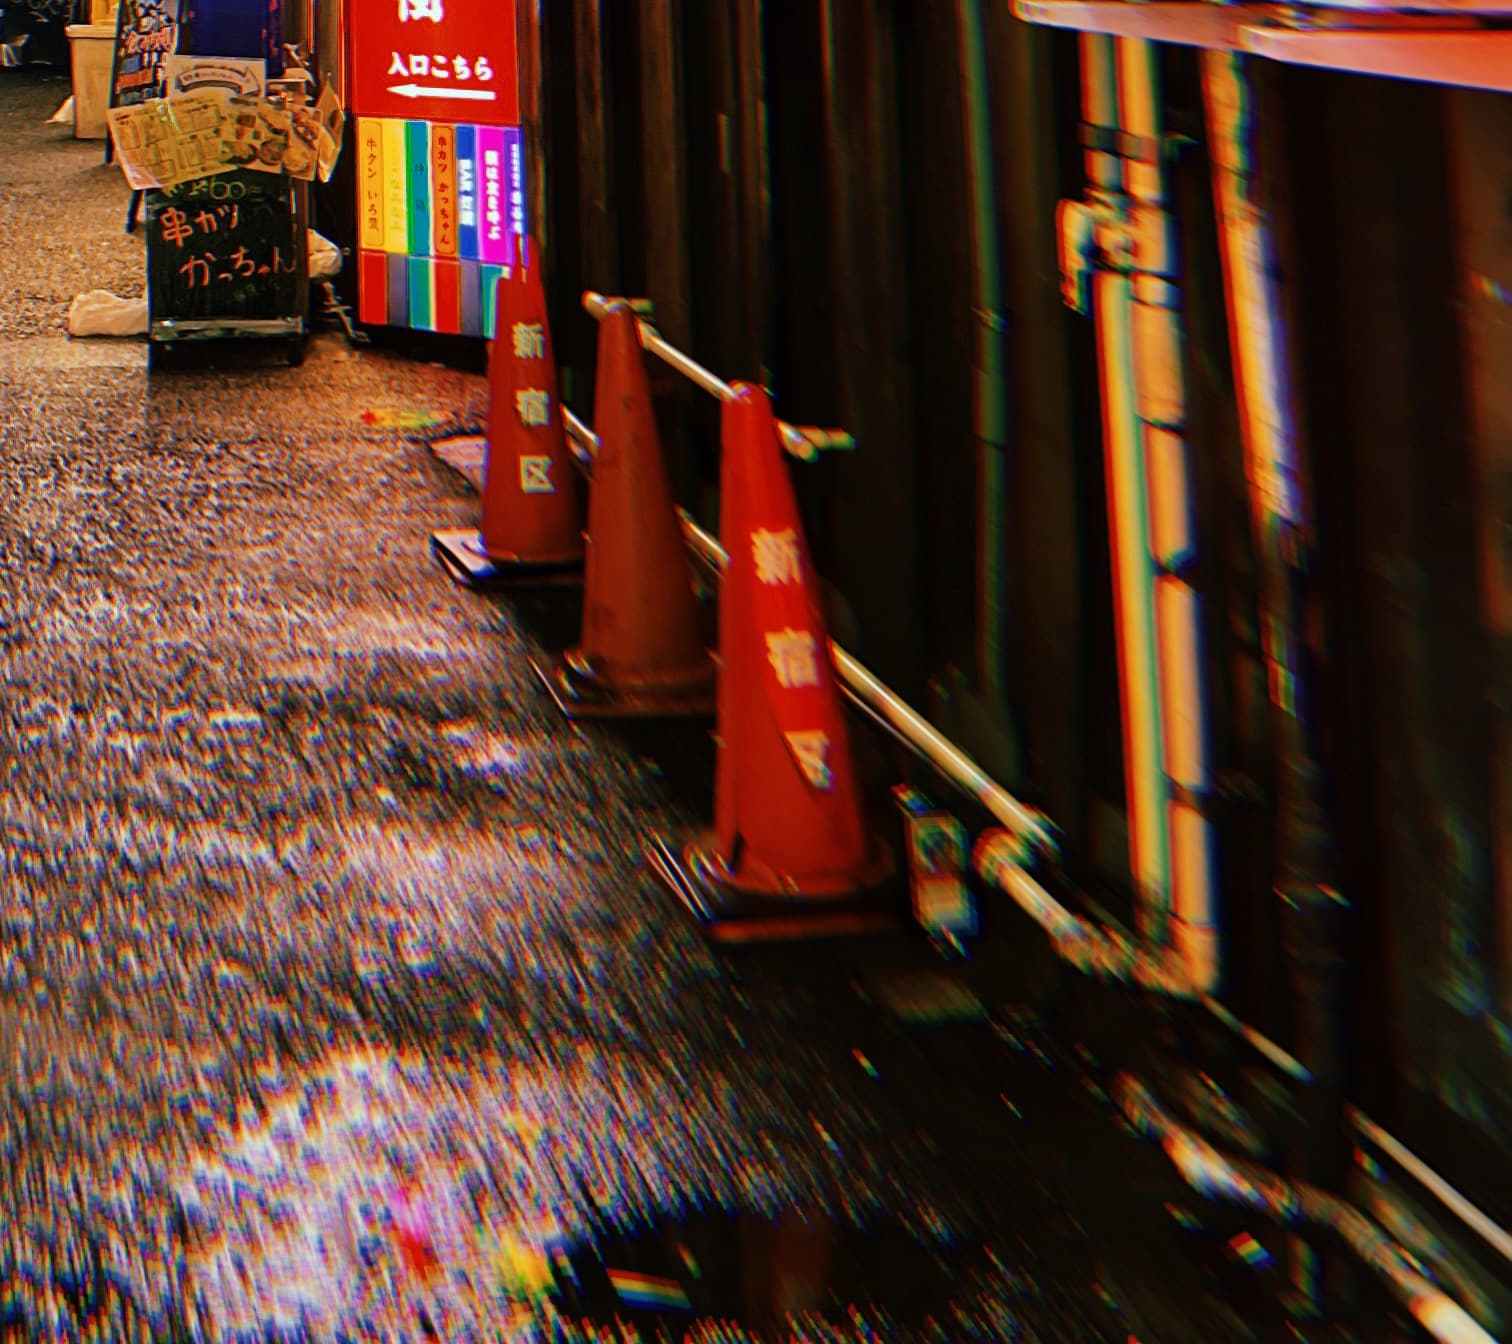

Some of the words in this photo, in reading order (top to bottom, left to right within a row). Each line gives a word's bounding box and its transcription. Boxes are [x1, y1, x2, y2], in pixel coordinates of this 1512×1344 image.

[387, 51, 495, 82] 入口こちら
